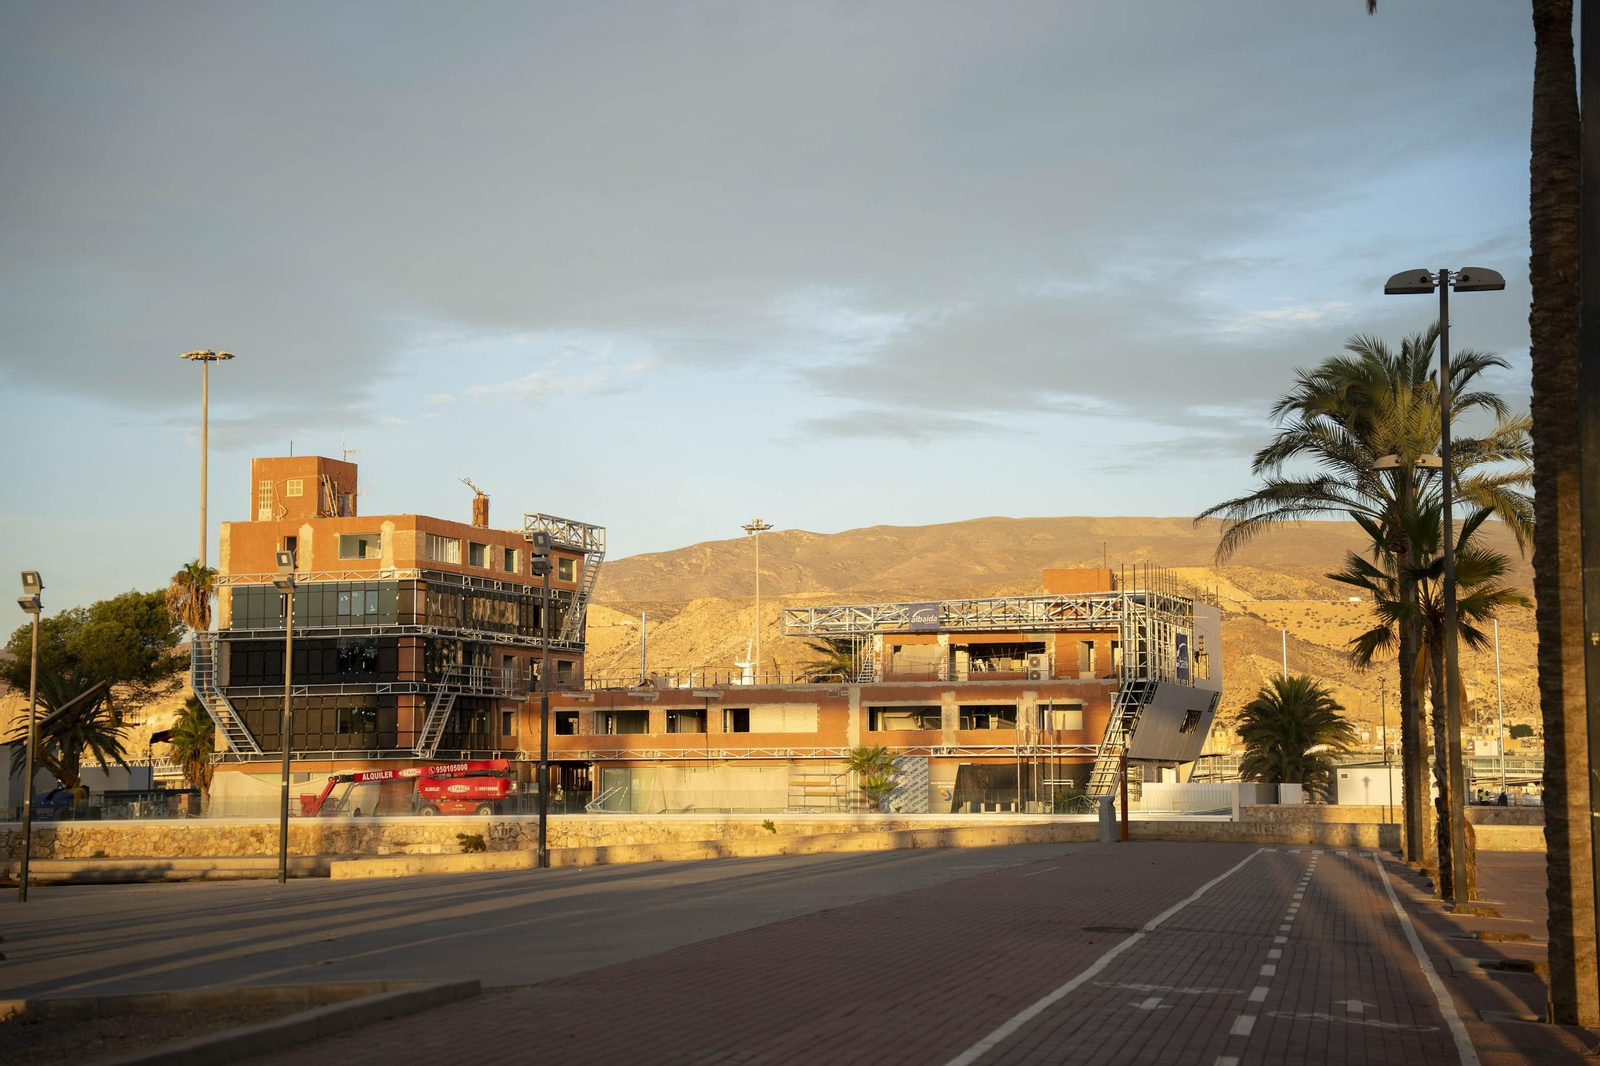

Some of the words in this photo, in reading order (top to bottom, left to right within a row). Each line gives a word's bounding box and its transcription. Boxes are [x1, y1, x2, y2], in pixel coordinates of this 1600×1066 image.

[911, 614, 938, 623] albaida
[362, 770, 393, 781] ALQUILER
[435, 763, 468, 774] 950105000
